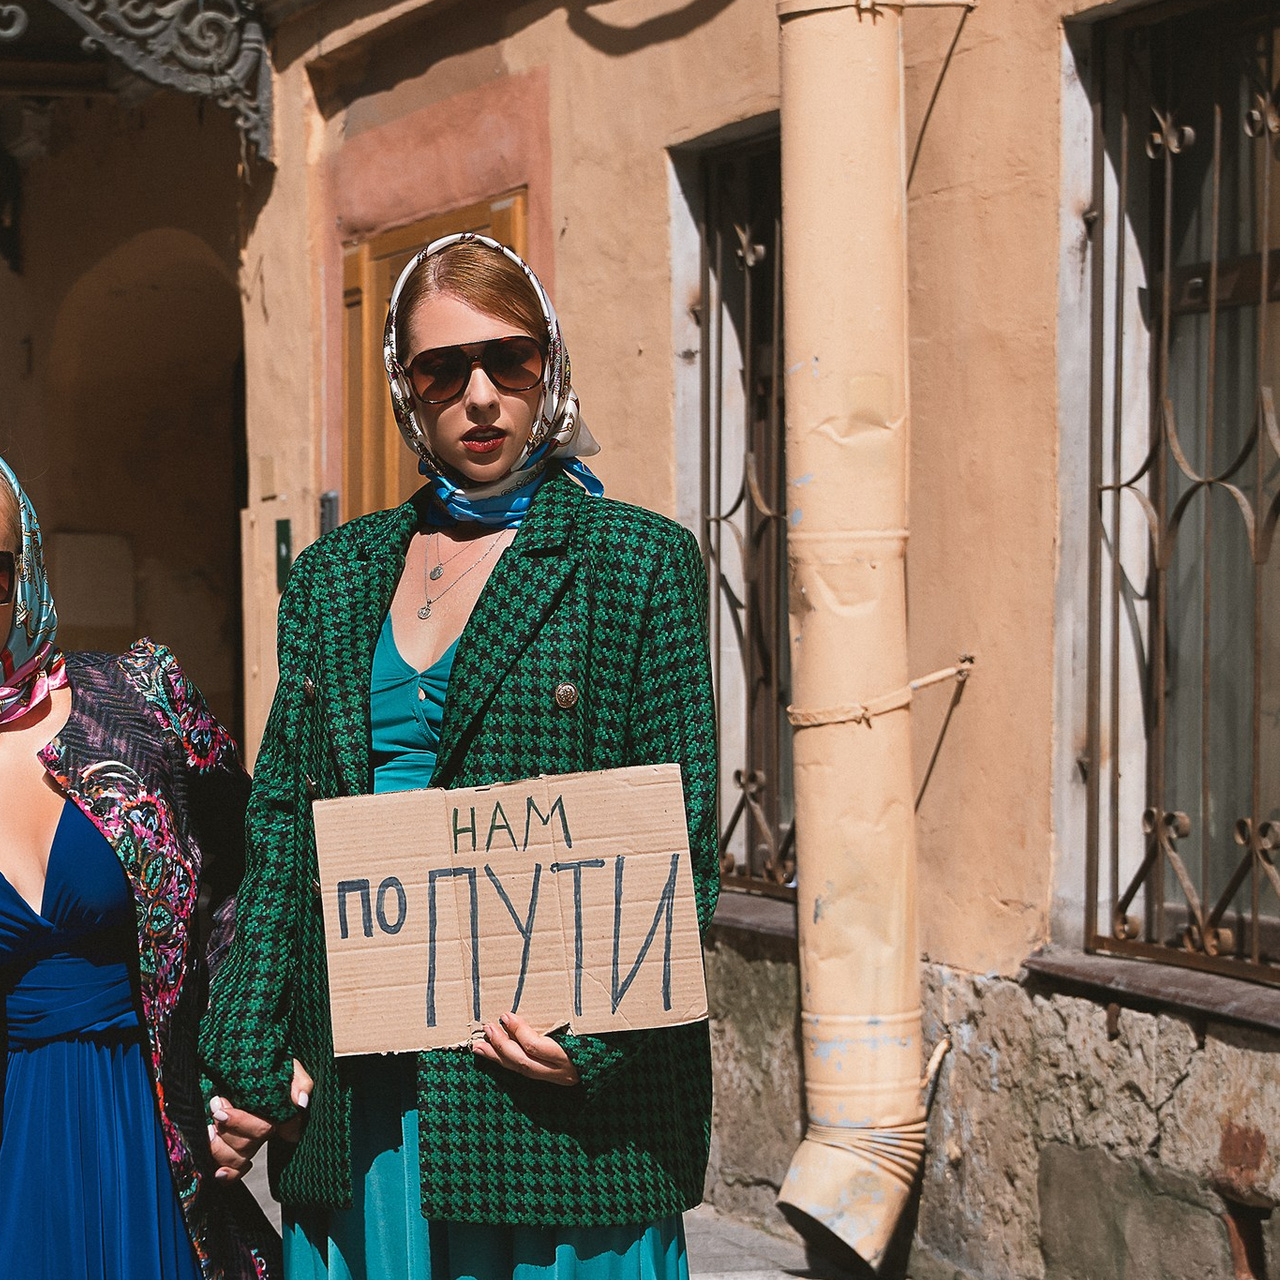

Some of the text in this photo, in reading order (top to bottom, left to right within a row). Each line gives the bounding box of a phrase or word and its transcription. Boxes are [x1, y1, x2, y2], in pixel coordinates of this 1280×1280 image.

[452, 795, 572, 854] НАМ
[337, 853, 679, 1028] ПО ПУТИ
